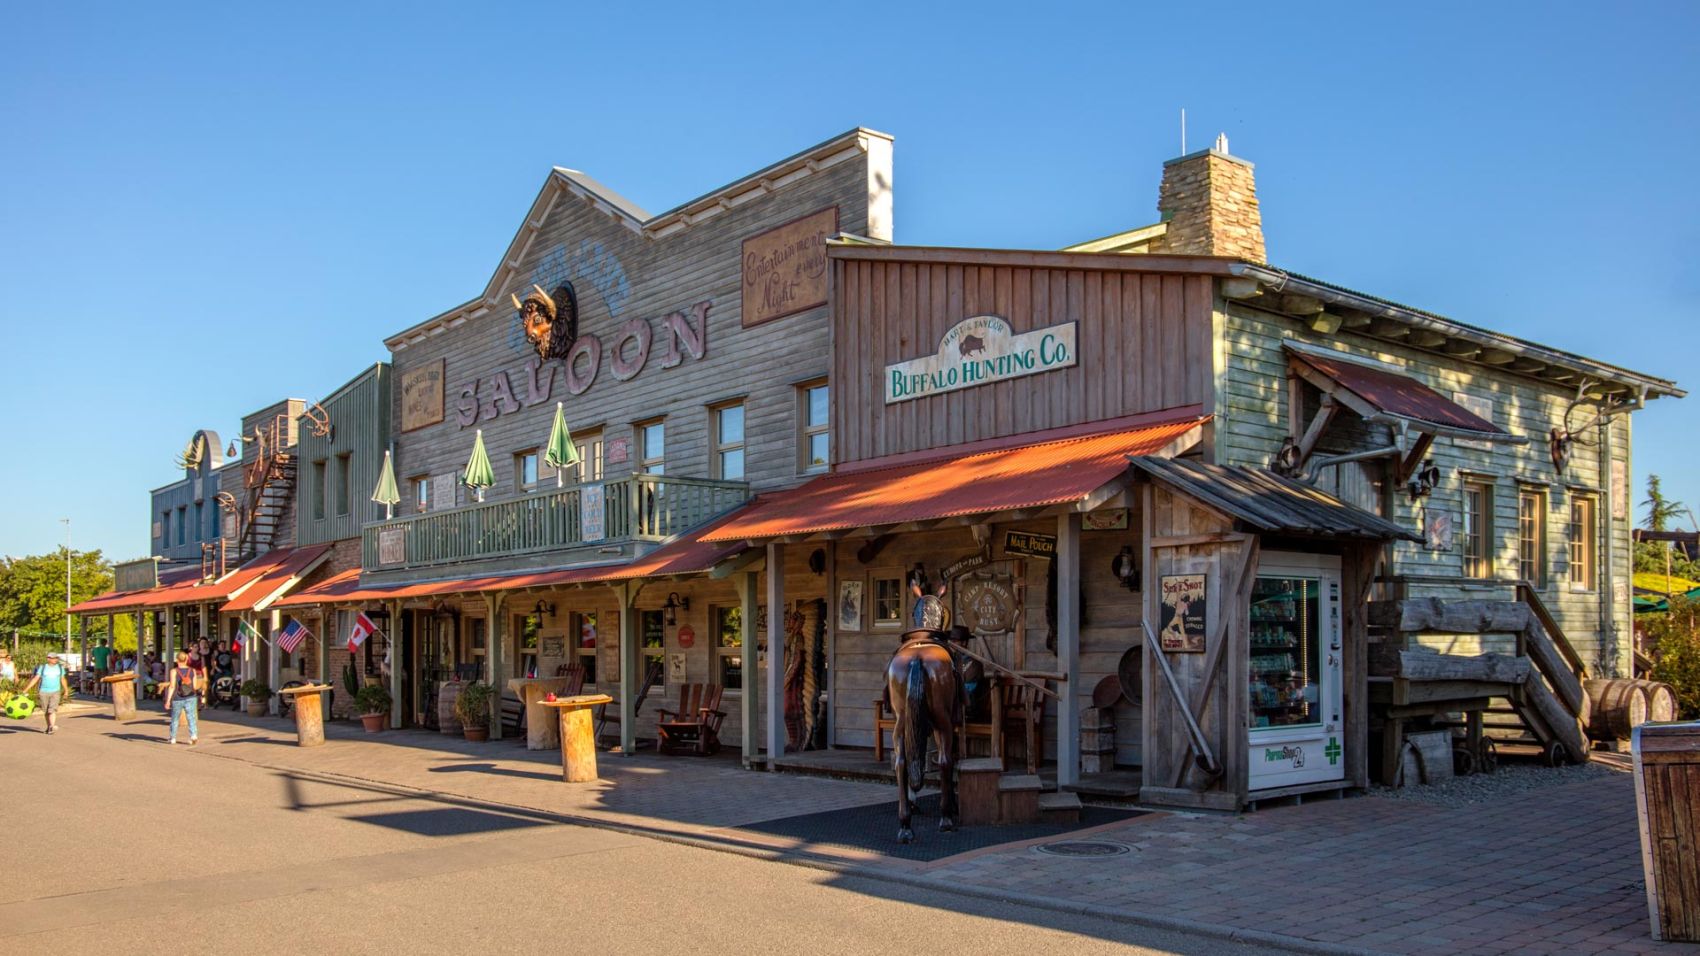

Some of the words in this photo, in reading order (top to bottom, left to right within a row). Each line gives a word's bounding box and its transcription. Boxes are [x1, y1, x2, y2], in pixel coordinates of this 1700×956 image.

[745, 230, 825, 287] Entertainment
[757, 271, 800, 314] Night
[974, 320, 1003, 333] TAYLOR
[455, 300, 711, 430] SALOON
[892, 367, 958, 398] BUFFALO
[962, 348, 1035, 383] HUNTING
[1029, 537, 1053, 552] POUCH
